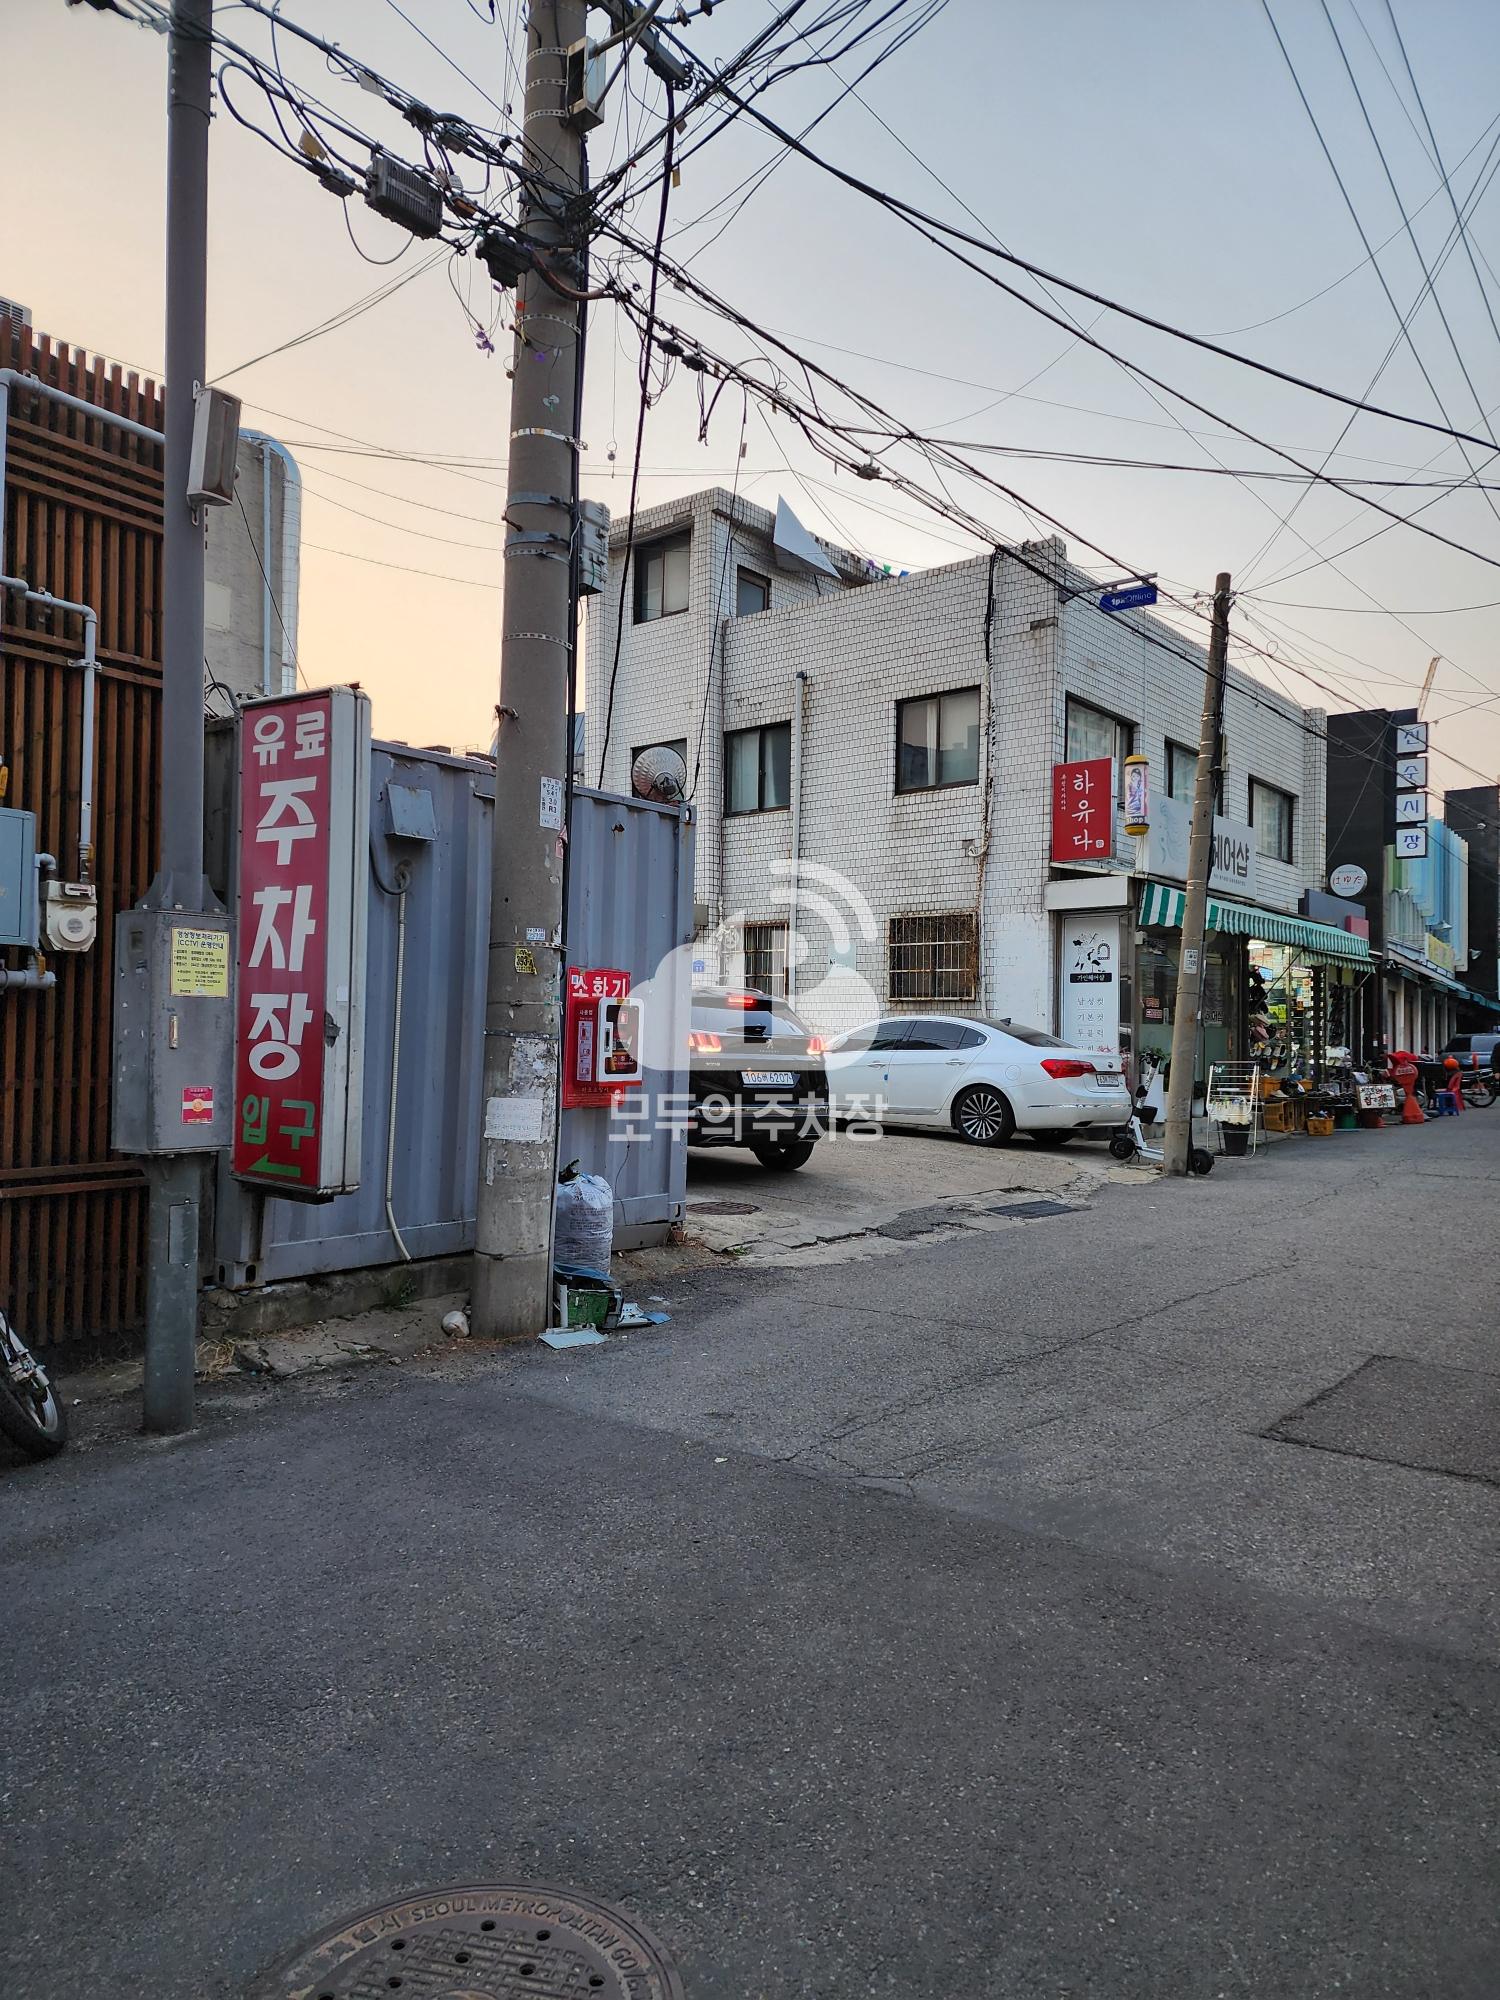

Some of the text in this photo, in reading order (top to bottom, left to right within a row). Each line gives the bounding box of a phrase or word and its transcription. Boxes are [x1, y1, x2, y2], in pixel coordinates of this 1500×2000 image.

[252, 710, 325, 766] 유료
[1071, 769, 1095, 852] 하유다
[1403, 730, 1421, 850] 신수시장
[247, 775, 317, 1081] 주차장
[242, 1094, 316, 1150] 입구
[411, 1898, 476, 1922] SEOUL
